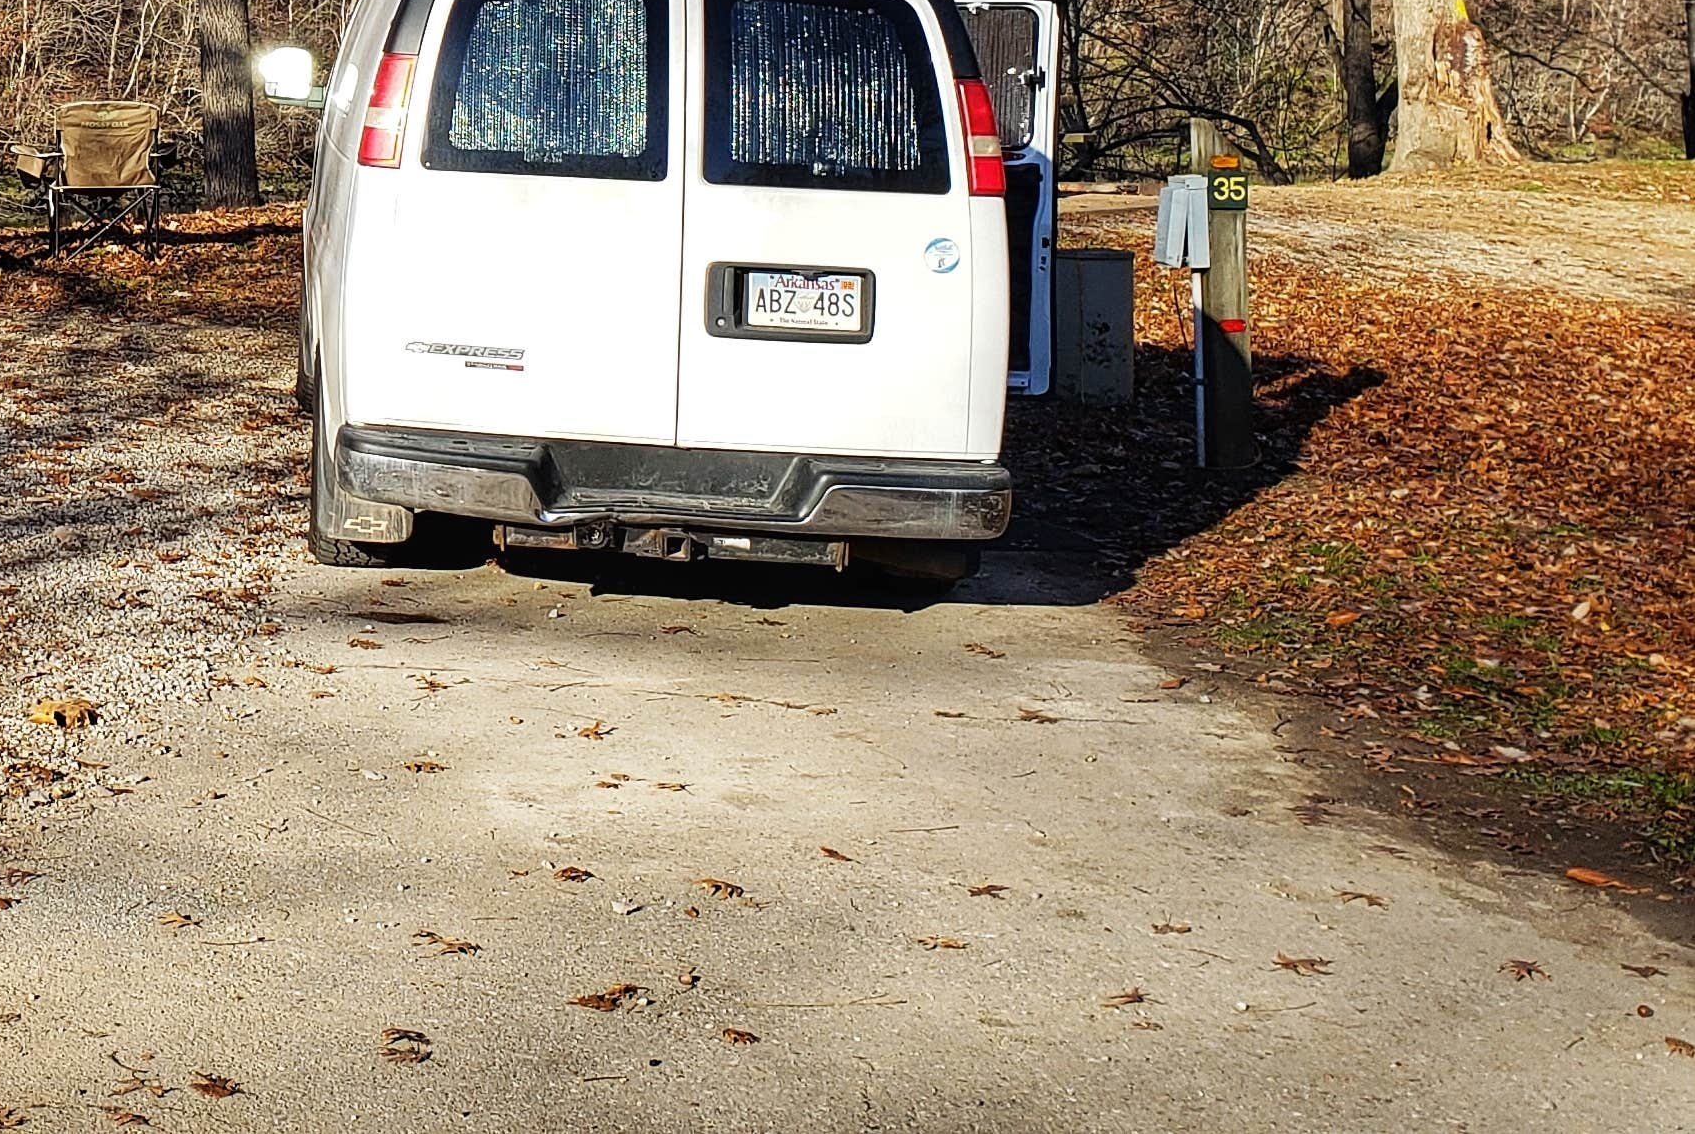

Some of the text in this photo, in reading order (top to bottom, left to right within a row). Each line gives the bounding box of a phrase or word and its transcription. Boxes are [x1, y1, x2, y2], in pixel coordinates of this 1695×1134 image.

[1213, 177, 1246, 201] 35
[774, 274, 835, 291] Arkansas
[755, 288, 855, 317] ABZ 48S
[427, 343, 525, 360] EXPRESS
